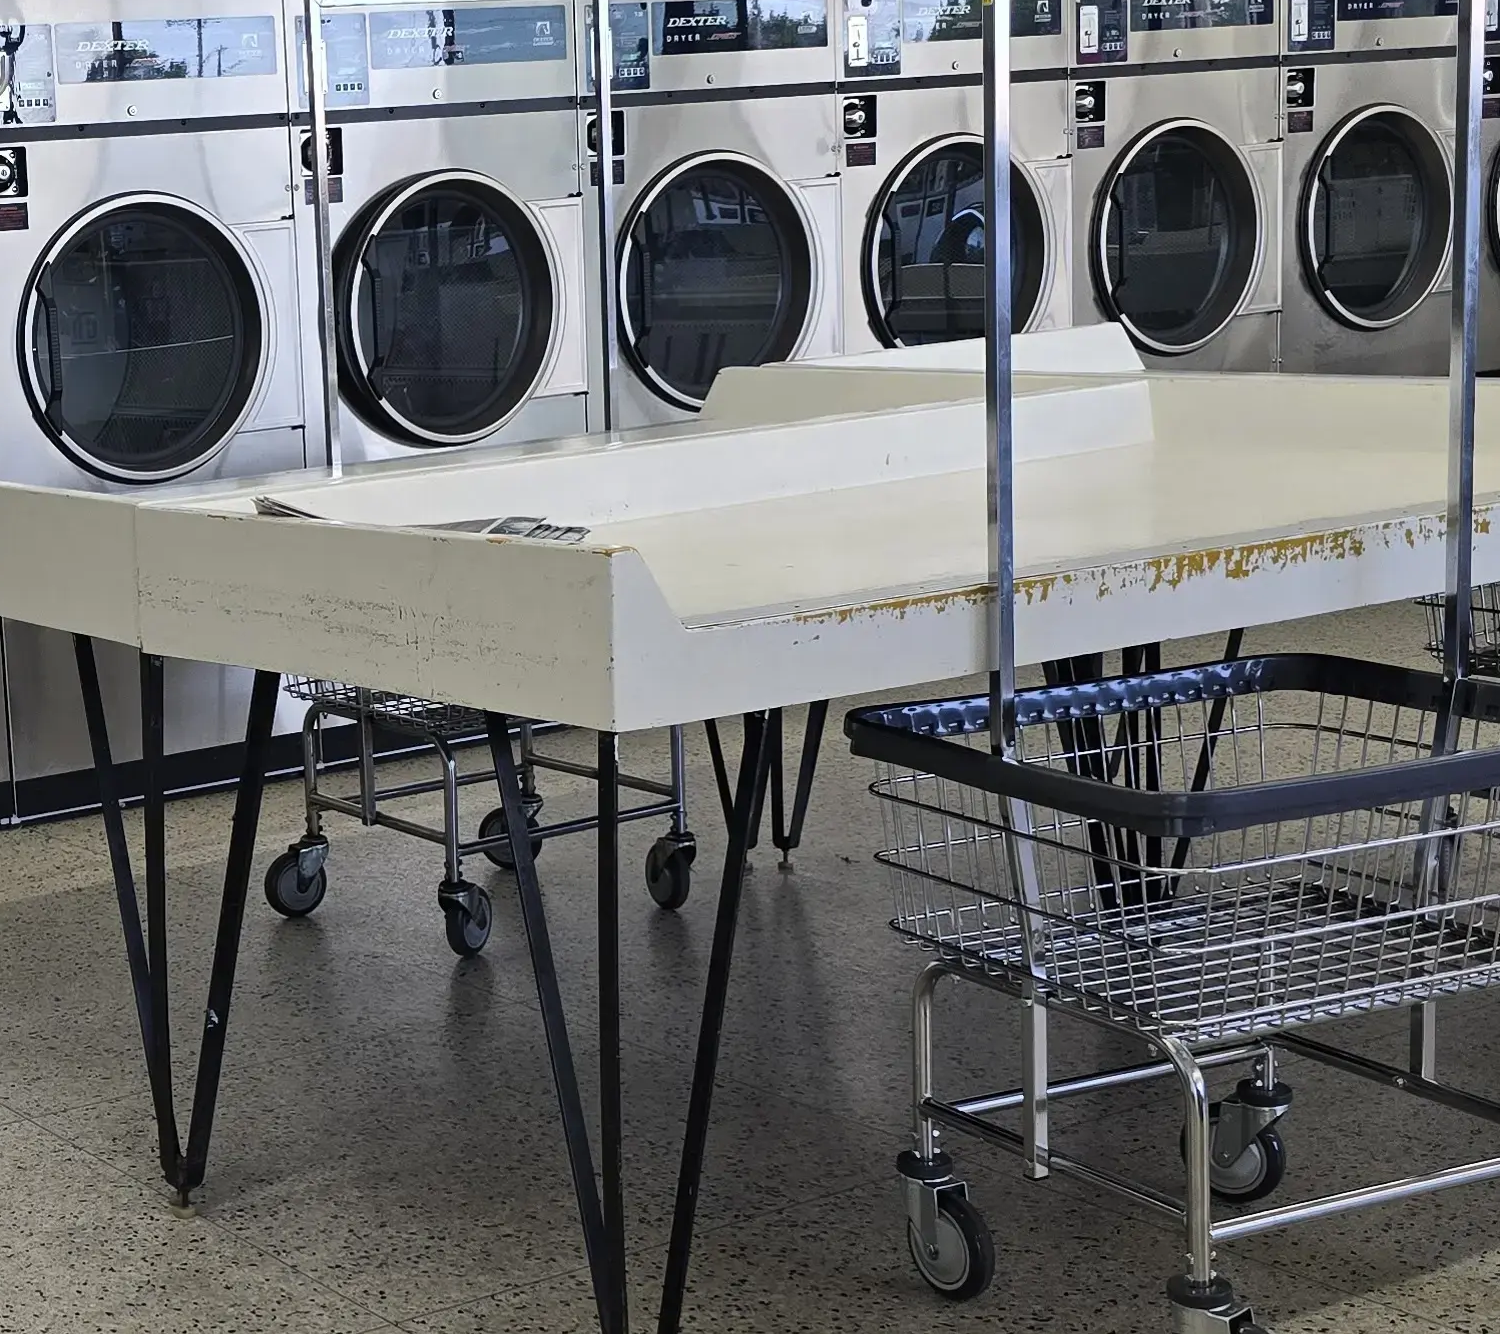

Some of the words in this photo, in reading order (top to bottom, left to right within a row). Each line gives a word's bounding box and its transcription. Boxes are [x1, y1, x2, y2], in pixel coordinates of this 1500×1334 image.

[916, 5, 971, 16] DEXTER
[667, 15, 727, 28] DEXTER
[387, 27, 454, 39] DEXTER
[666, 34, 701, 43] DRYER
[76, 39, 150, 52] DEXTER
